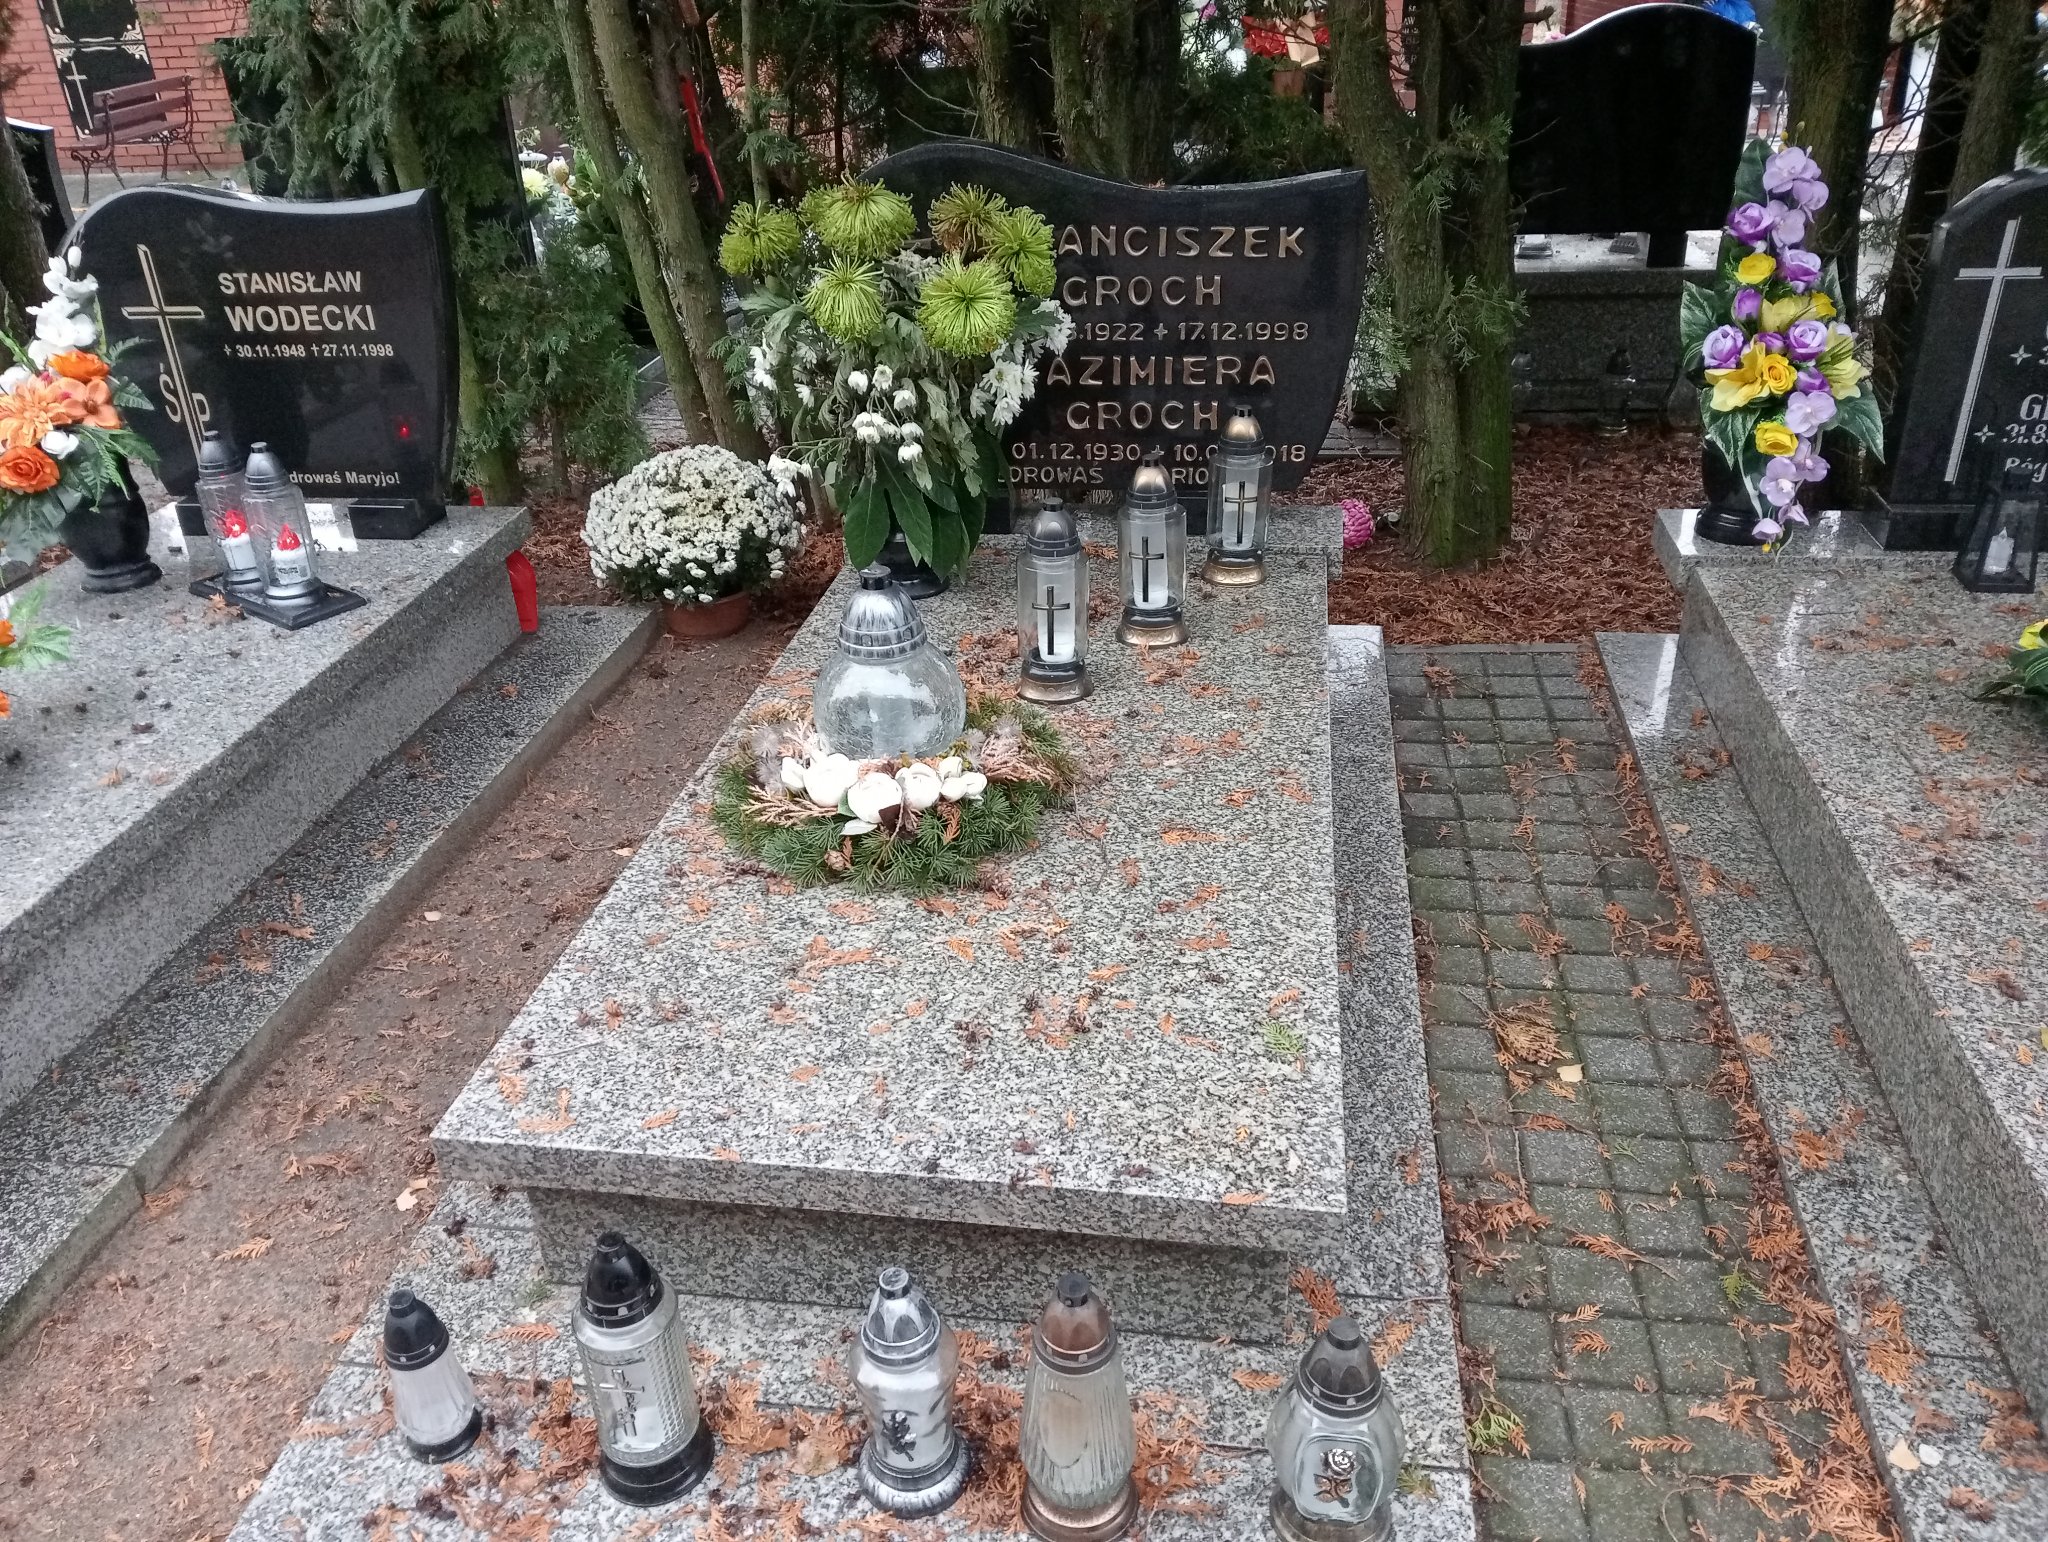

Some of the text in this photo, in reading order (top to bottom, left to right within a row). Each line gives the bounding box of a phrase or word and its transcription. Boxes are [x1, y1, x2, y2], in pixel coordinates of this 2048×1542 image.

[1058, 225, 1305, 258] ANCISZEK
[217, 271, 361, 294] STANISŁAW
[1062, 274, 1221, 306] GROCH
[224, 304, 376, 332] WODECKI
[1177, 322, 1309, 341] 17.12.1998
[236, 343, 394, 358] 30.11.1948 27.11.1998
[1046, 355, 1276, 386] AZIMIERA
[1066, 400, 1219, 431] GROCH
[1011, 442, 1141, 461] 01.12.1930
[289, 470, 401, 487] drowaś Maryjo!
[1171, 467, 1209, 485] RIO
